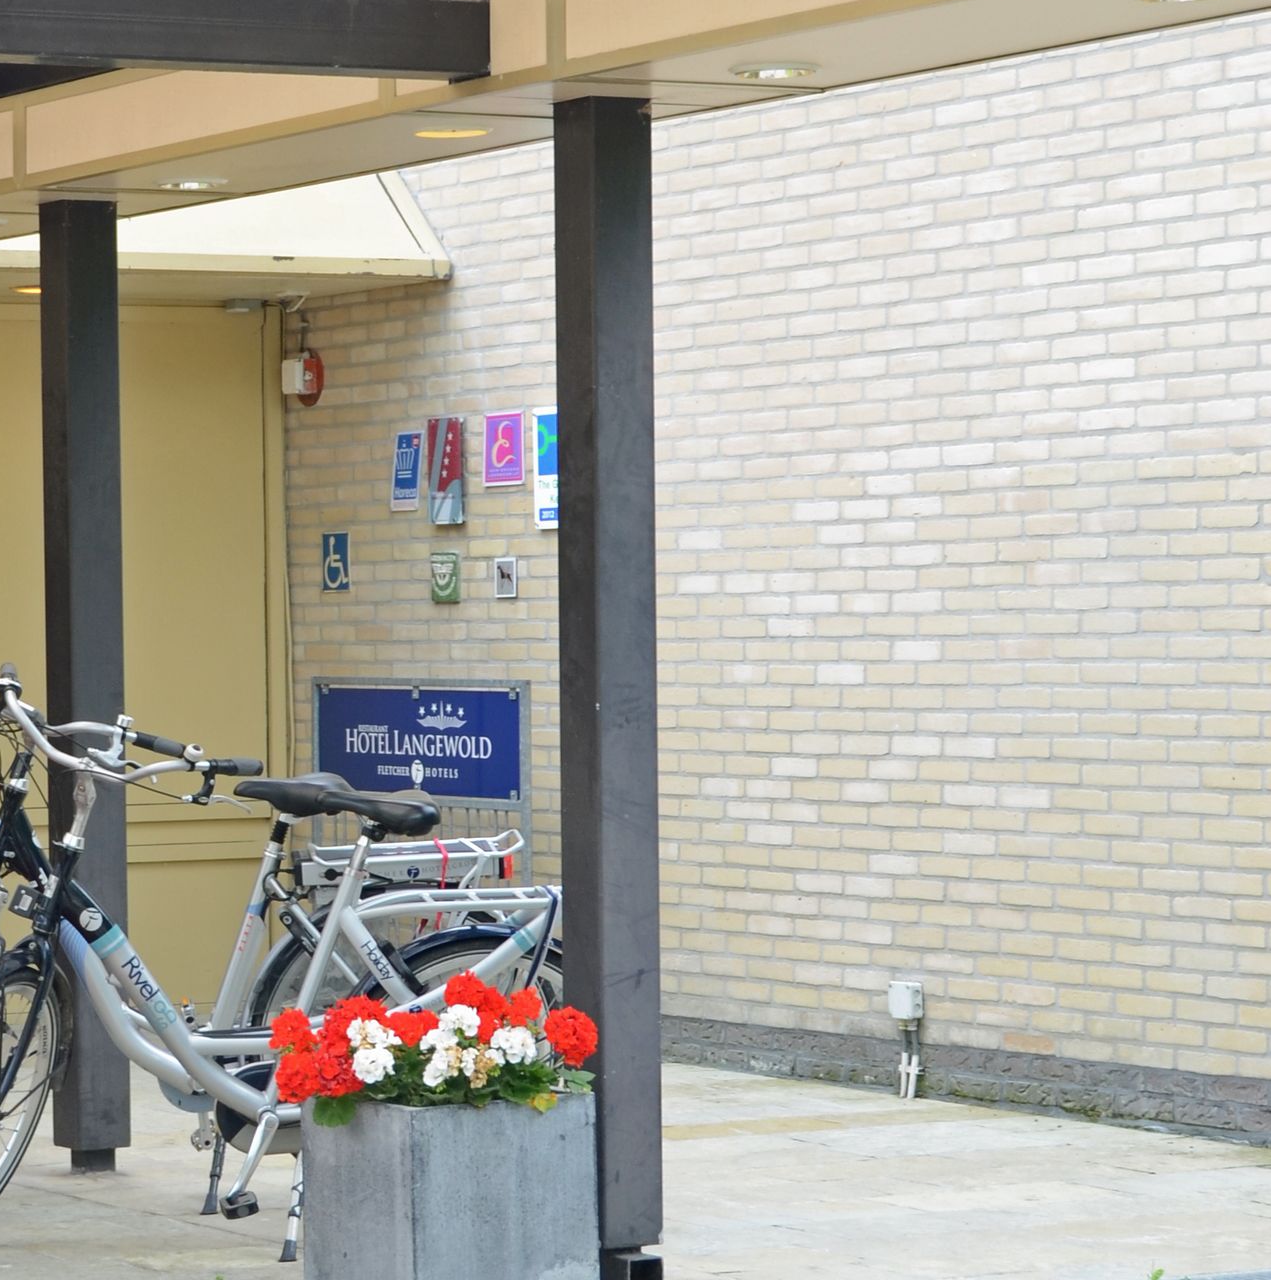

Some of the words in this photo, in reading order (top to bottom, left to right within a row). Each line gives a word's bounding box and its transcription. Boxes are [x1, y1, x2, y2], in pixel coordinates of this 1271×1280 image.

[345, 728, 392, 754] HOTEL
[394, 730, 492, 759] LANGEWOLD
[378, 765, 410, 776] FLETCHER
[425, 767, 459, 779] HOTELS
